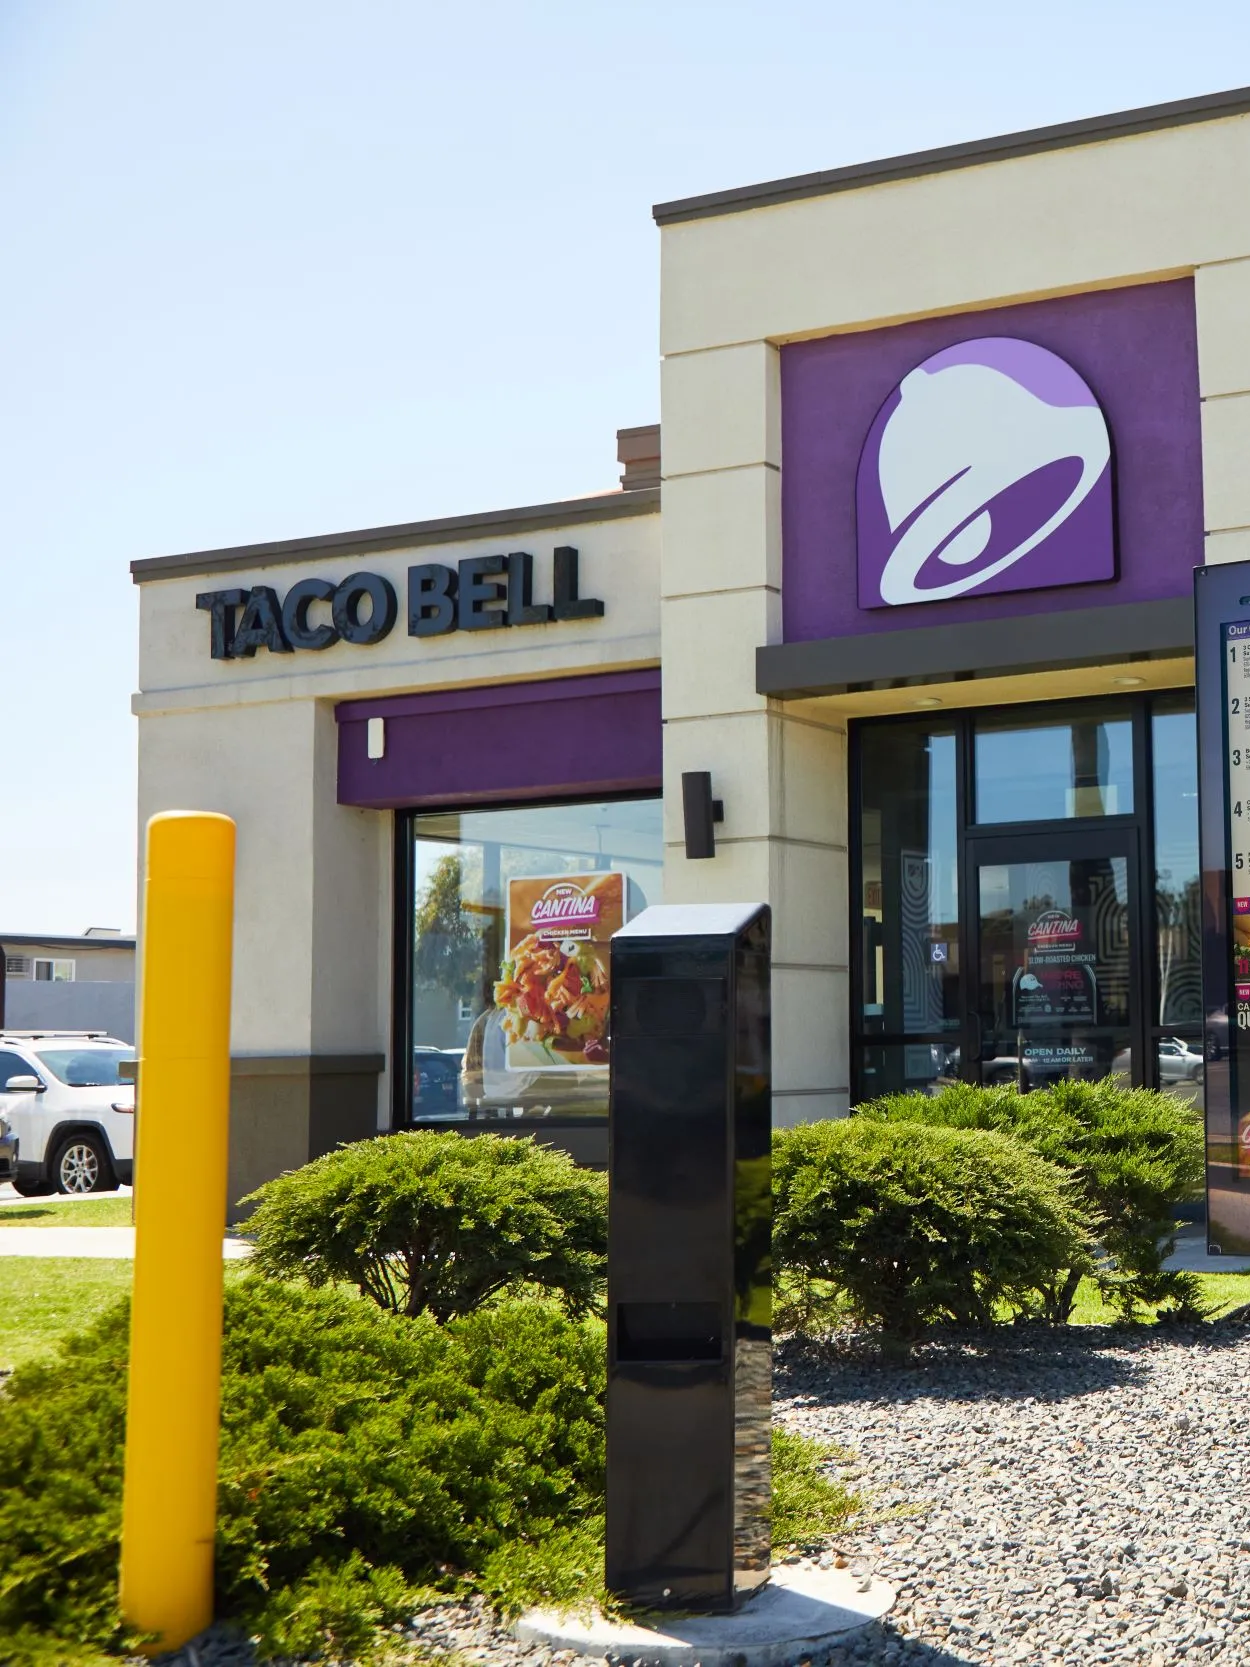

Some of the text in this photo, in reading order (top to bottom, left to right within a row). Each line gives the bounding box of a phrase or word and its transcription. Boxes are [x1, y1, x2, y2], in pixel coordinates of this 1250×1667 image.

[195, 545, 605, 660] TACO BELL
[1228, 625, 1247, 636] Our
[1230, 647, 1236, 663] 1
[1231, 698, 1240, 714] 2
[1233, 749, 1241, 766] 3
[1233, 801, 1243, 817] 4
[1235, 853, 1244, 870] 5
[531, 895, 596, 919] CANTINA
[543, 928, 588, 937] CHICKEN MENU
[1028, 919, 1079, 936] CANTINA
[1071, 953, 1096, 963] CHICKEN
[1025, 1047, 1086, 1056] OPEN DAILY
